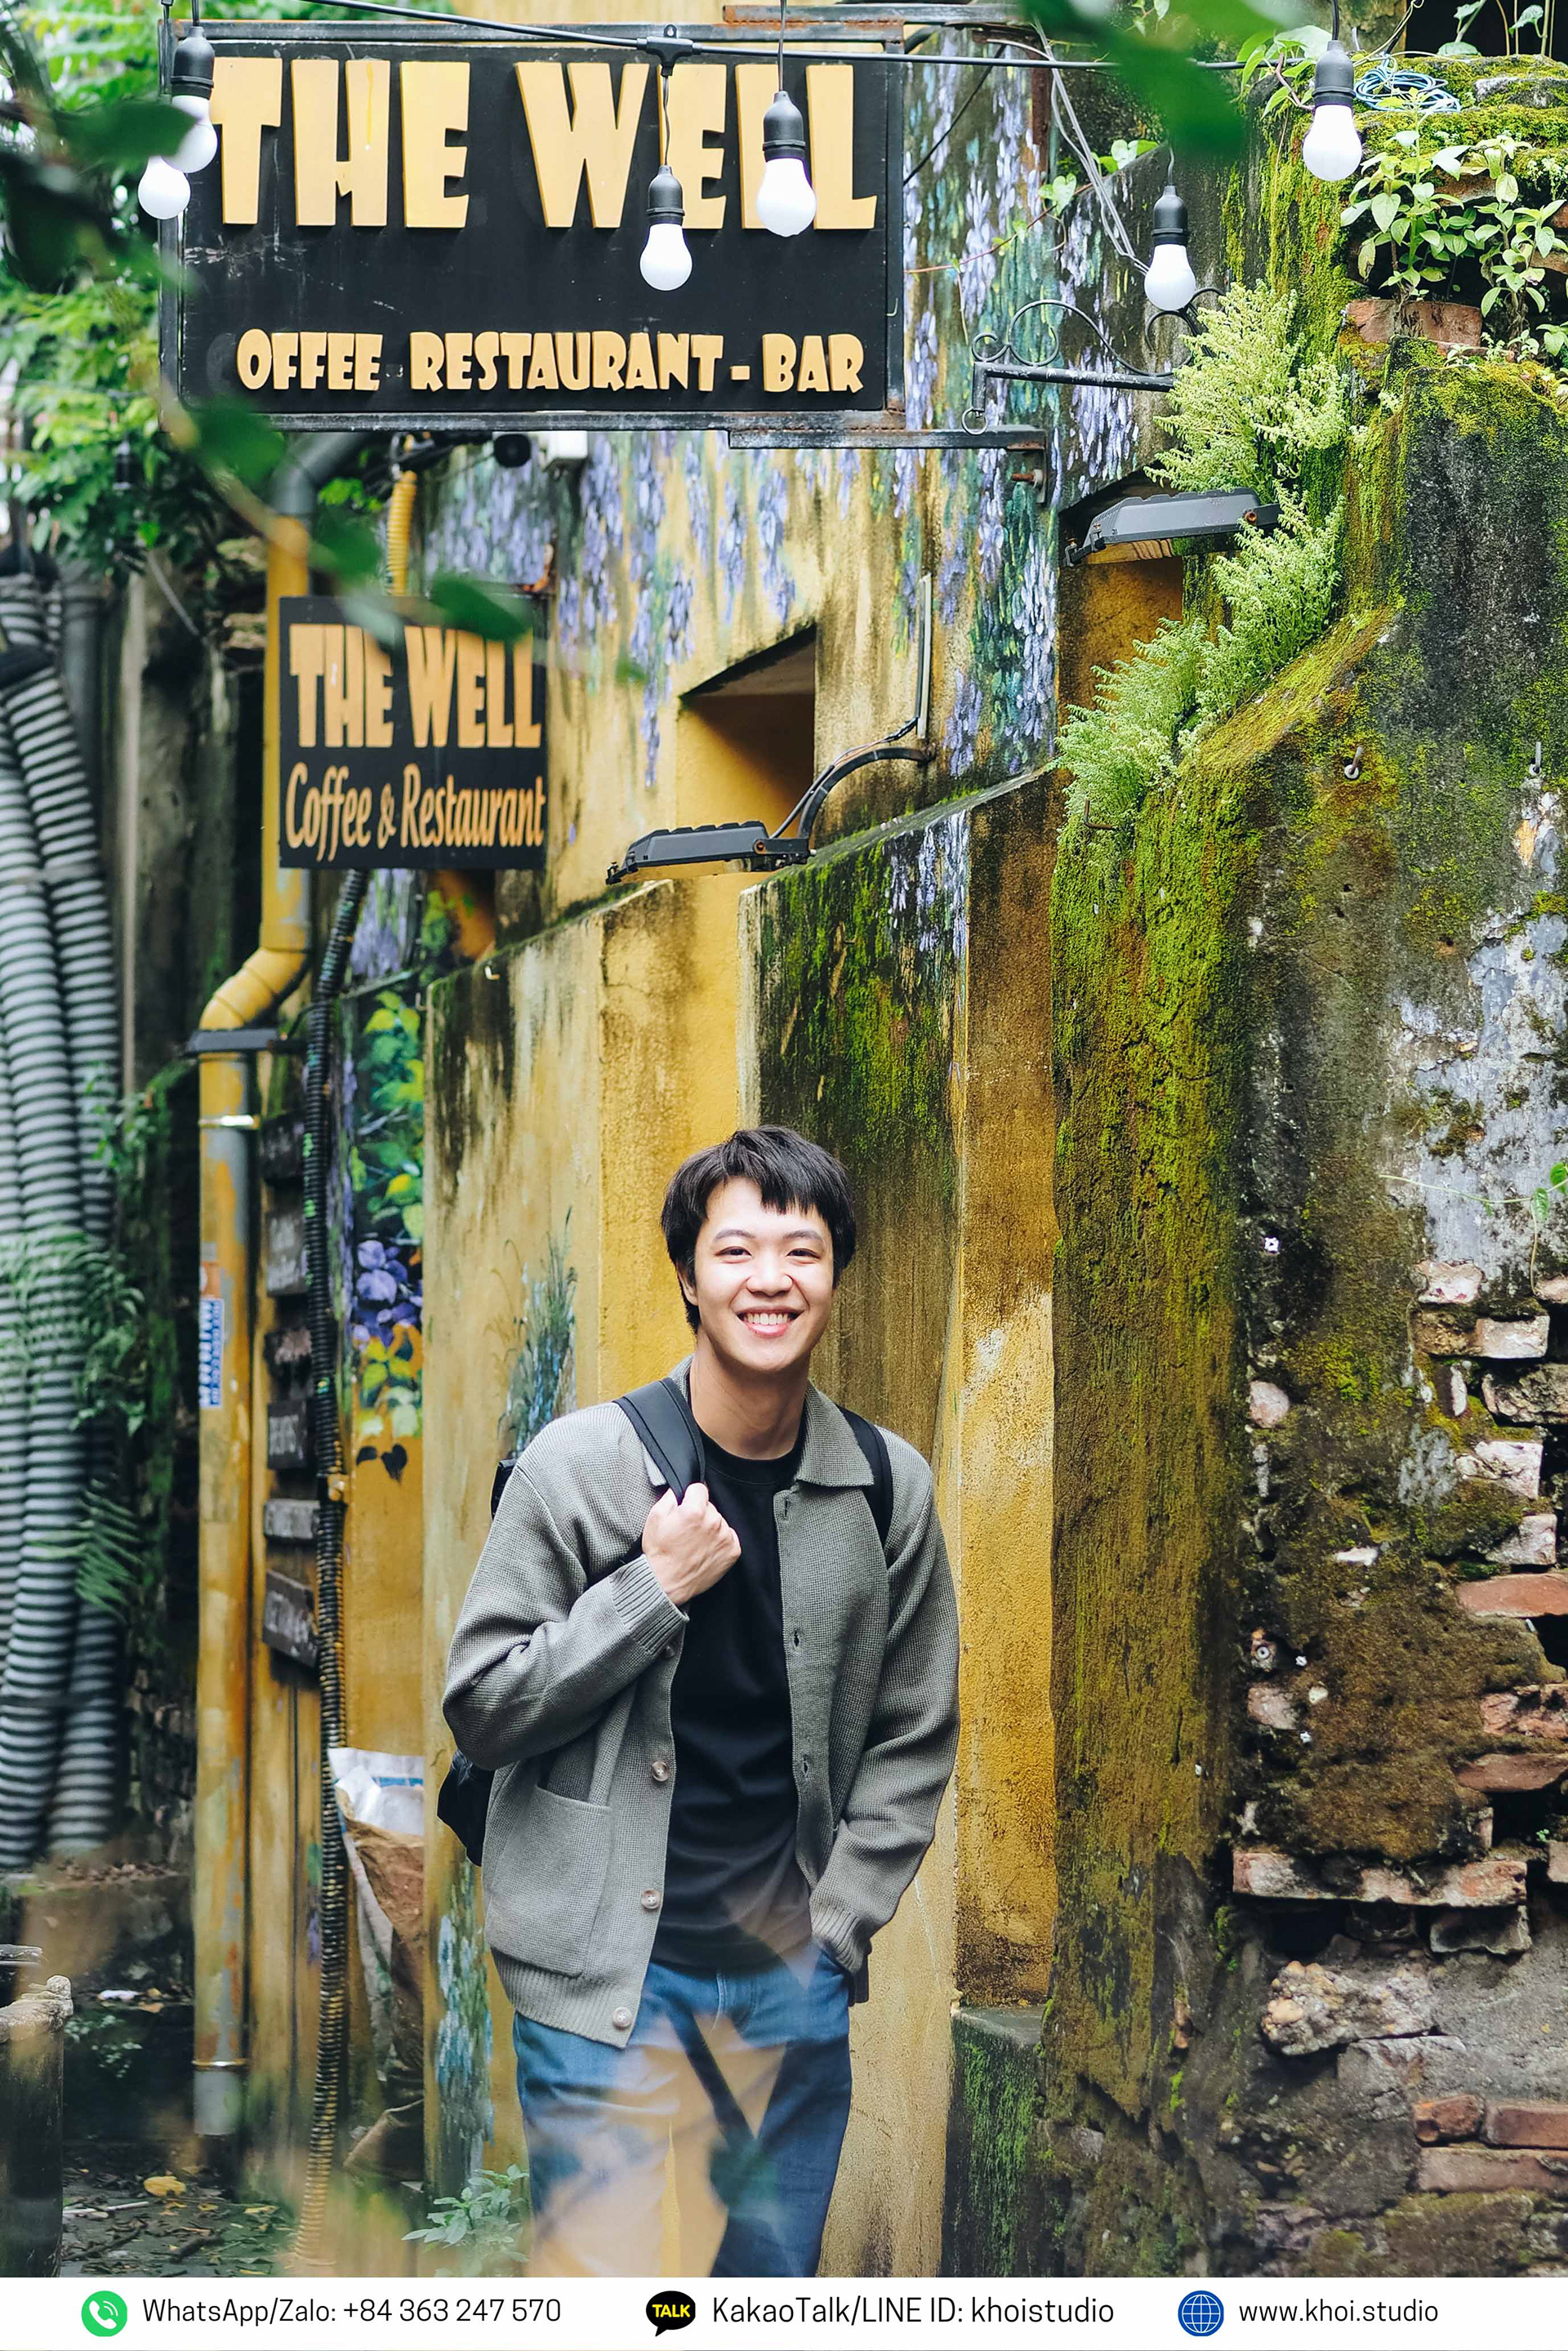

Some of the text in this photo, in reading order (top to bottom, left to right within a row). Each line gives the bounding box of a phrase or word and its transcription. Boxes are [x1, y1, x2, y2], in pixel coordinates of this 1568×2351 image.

[210, 57, 470, 229] THE
[410, 331, 724, 392] RESTAURANT
[762, 333, 864, 393] BAR
[289, 624, 541, 748] THE WELL
[286, 762, 546, 862] Coffee & Restaurant
